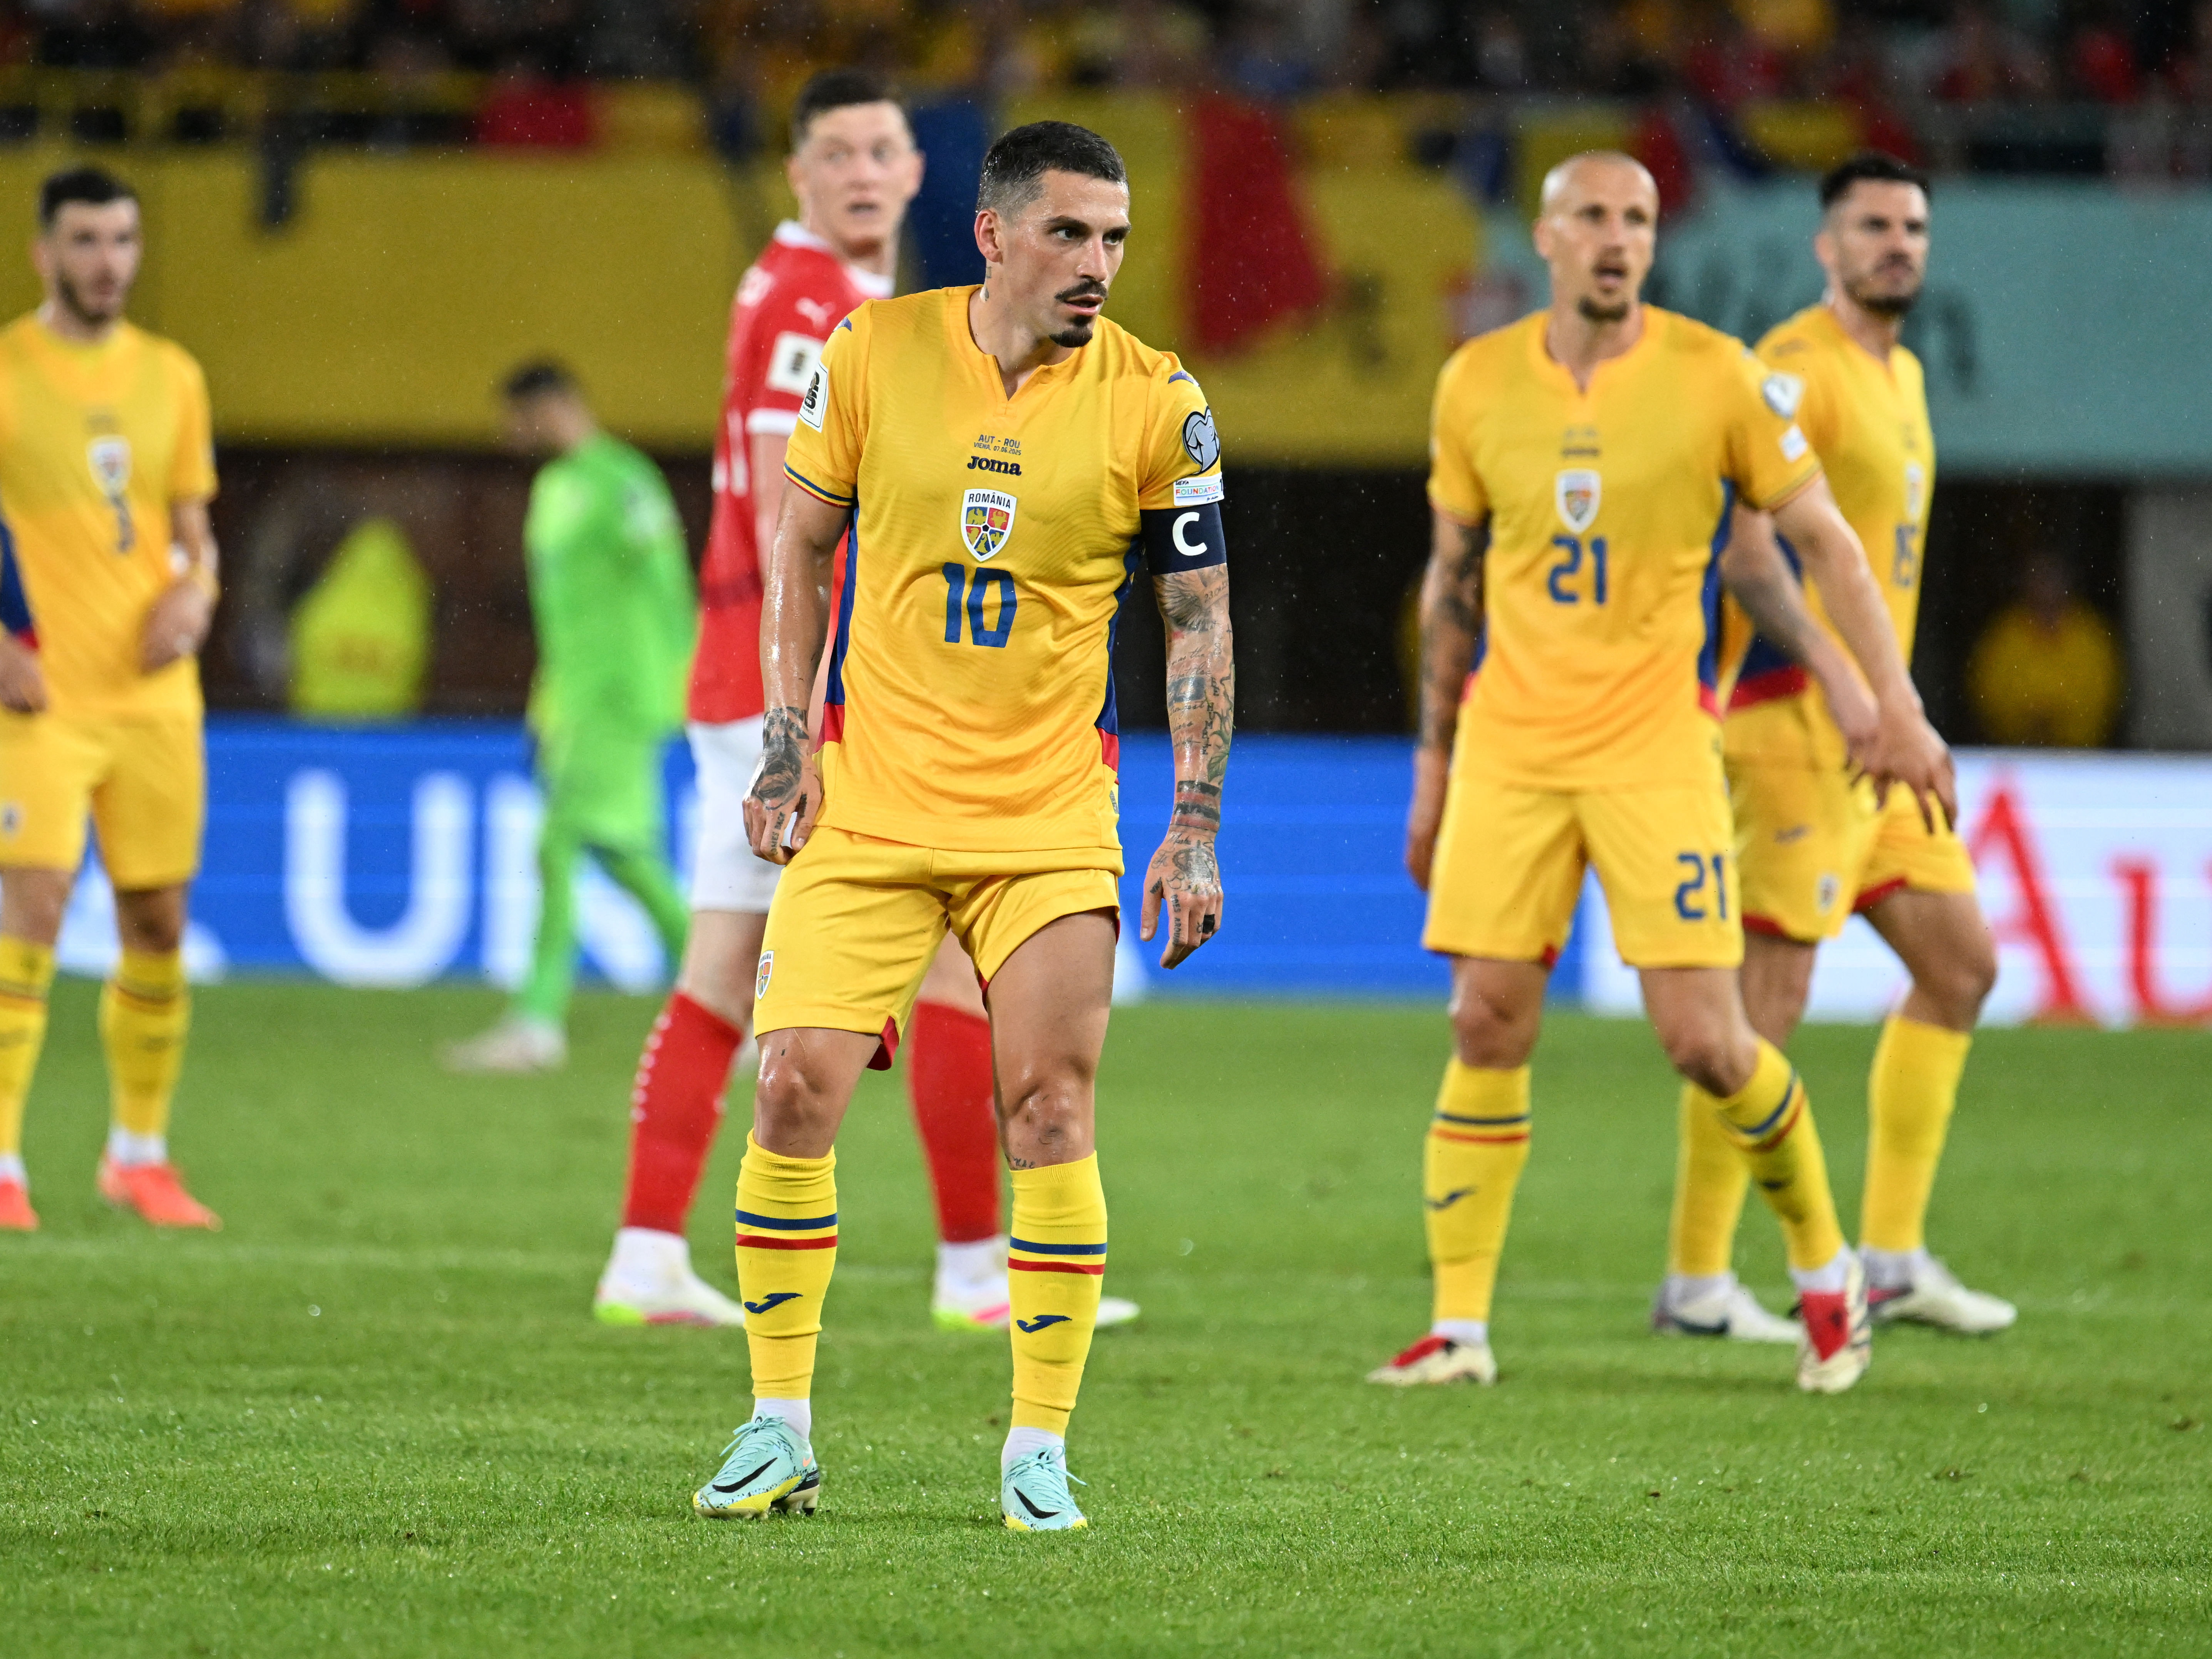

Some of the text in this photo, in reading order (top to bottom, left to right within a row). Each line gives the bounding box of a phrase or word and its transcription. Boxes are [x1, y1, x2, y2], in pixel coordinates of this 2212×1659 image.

[974, 442, 1021, 455] VIENA, 07.06.2025
[978, 434, 995, 444] AUT
[1004, 439, 1020, 448] ROU
[968, 492, 1010, 509] ROMÂNIA
[1175, 485, 1219, 496] FOUNDATION
[1172, 511, 1207, 556] C
[1547, 534, 1608, 605] 21
[942, 562, 1017, 648] 10
[1674, 852, 1727, 920] 21
